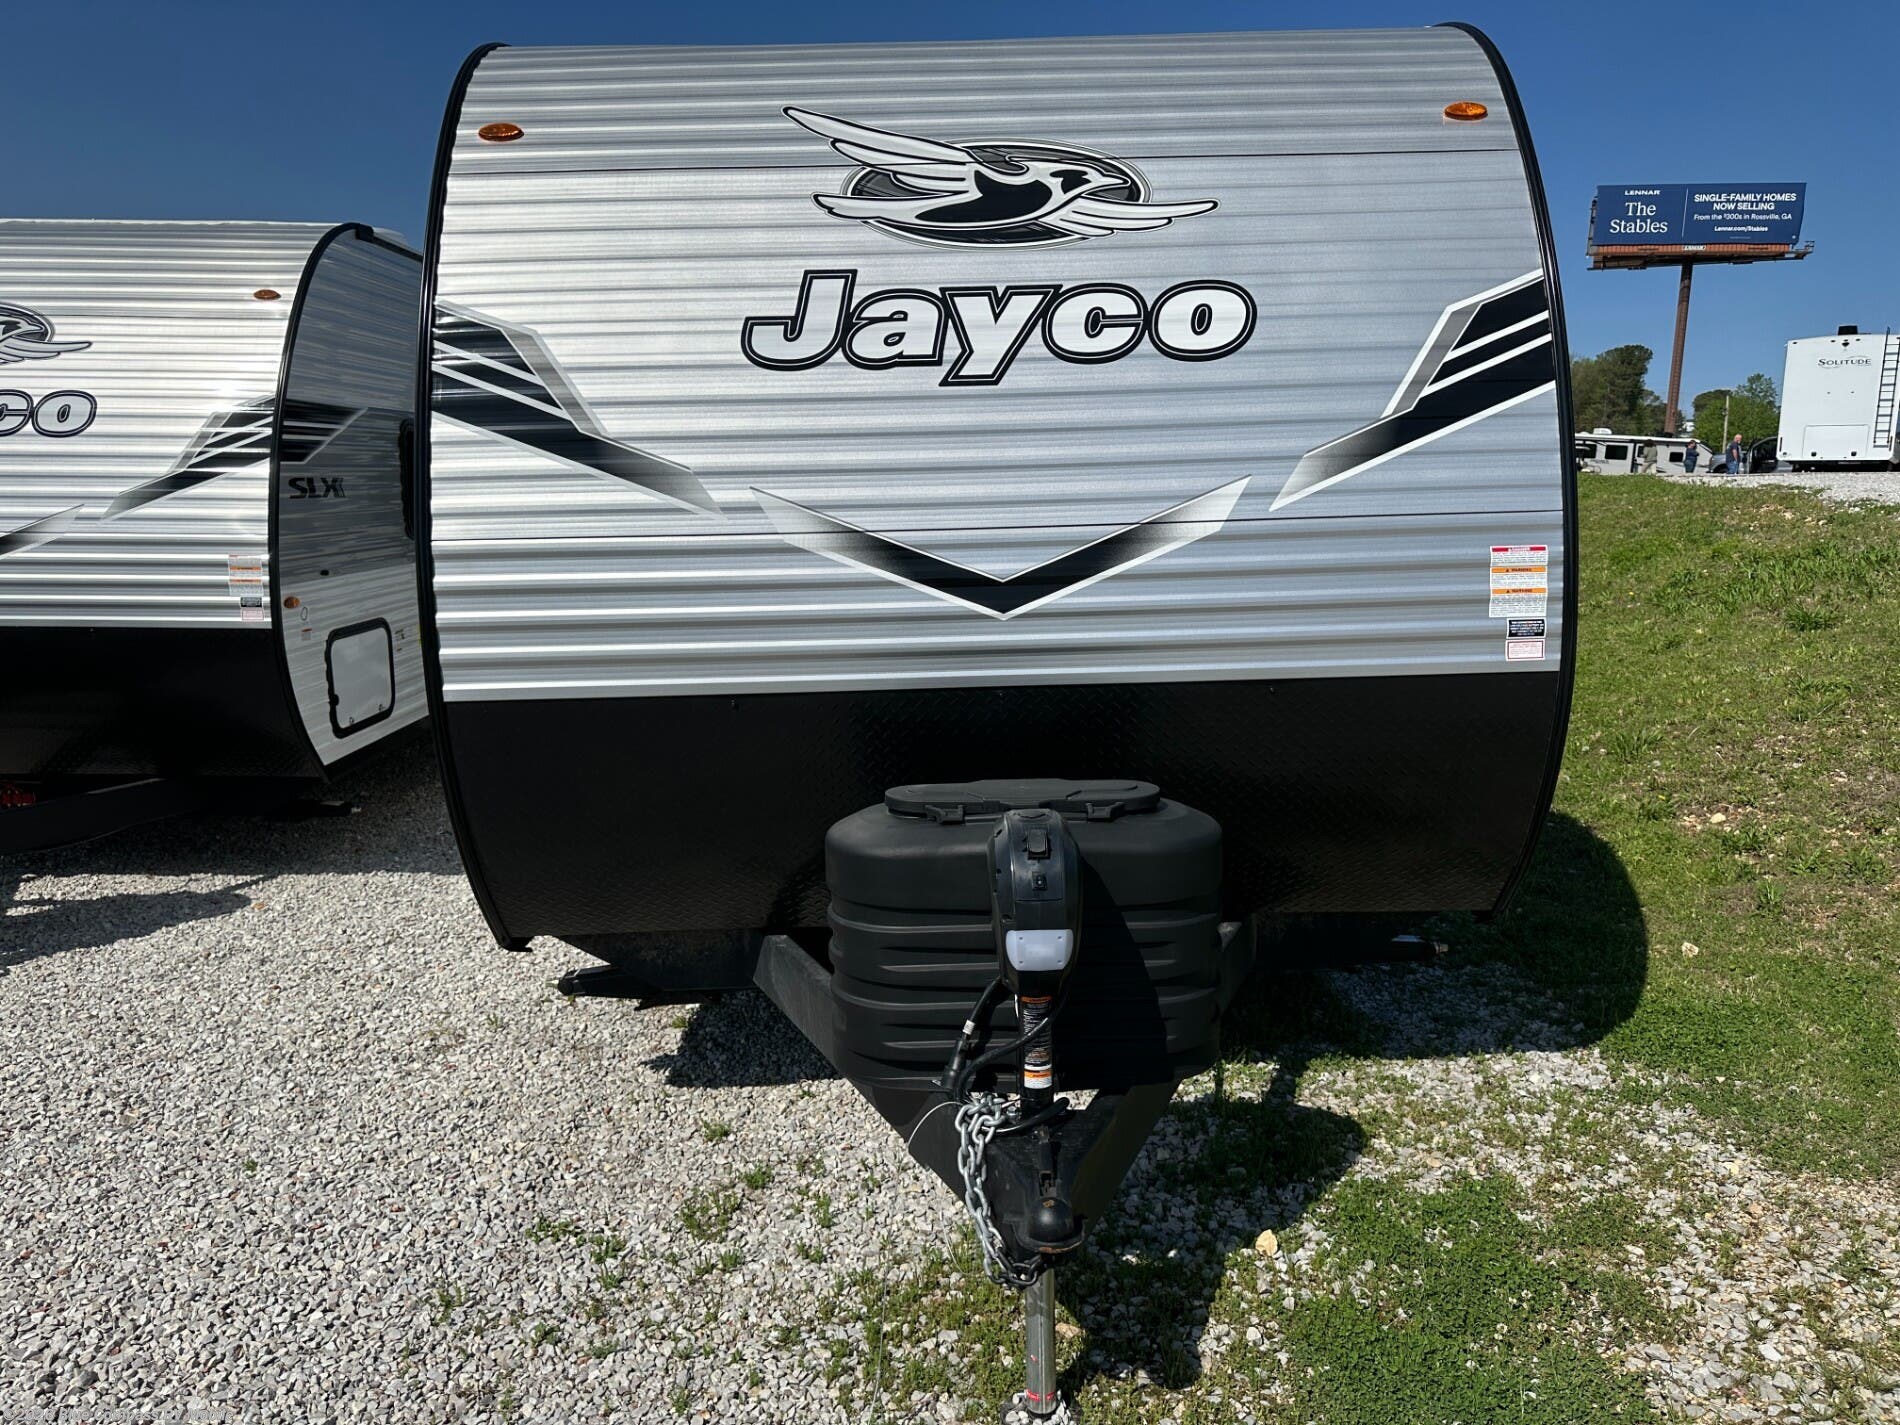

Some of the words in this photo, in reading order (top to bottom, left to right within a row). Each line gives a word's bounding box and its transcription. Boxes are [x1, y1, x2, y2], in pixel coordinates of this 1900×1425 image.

[1694, 193, 1762, 203] SINGLE-FAMILY
[1763, 193, 1797, 202] HOMES
[1625, 201, 1657, 216] The
[1713, 202, 1736, 211] NOW
[1737, 202, 1775, 211] SELLING
[1609, 218, 1669, 234] Stables
[741, 268, 1259, 387] Jayco
[1817, 358, 1872, 367] SOLITUDE
